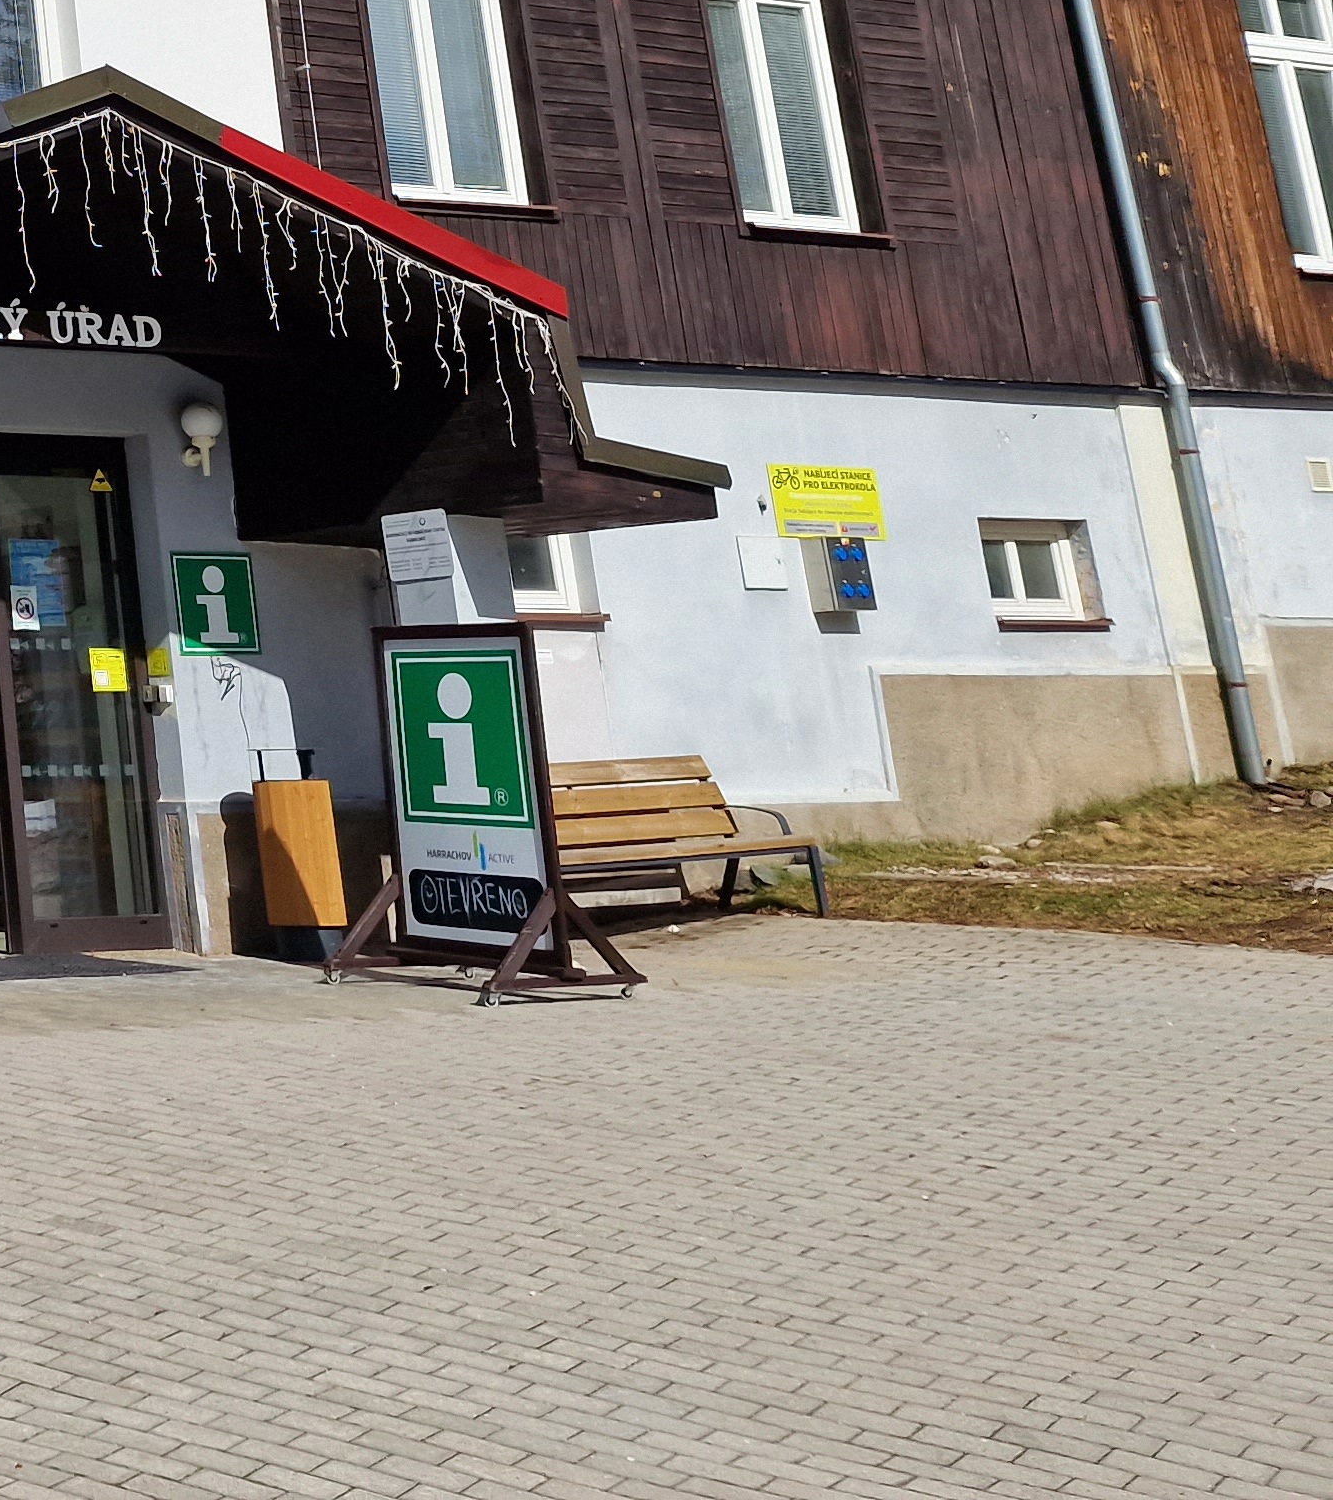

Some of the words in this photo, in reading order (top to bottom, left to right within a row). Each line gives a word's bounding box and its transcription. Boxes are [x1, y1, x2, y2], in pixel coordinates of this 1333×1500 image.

[46, 302, 162, 348] ÚŘAD
[803, 481, 819, 489] PRO
[427, 850, 471, 860] HARRACHOV
[489, 853, 514, 864] ACTIVE
